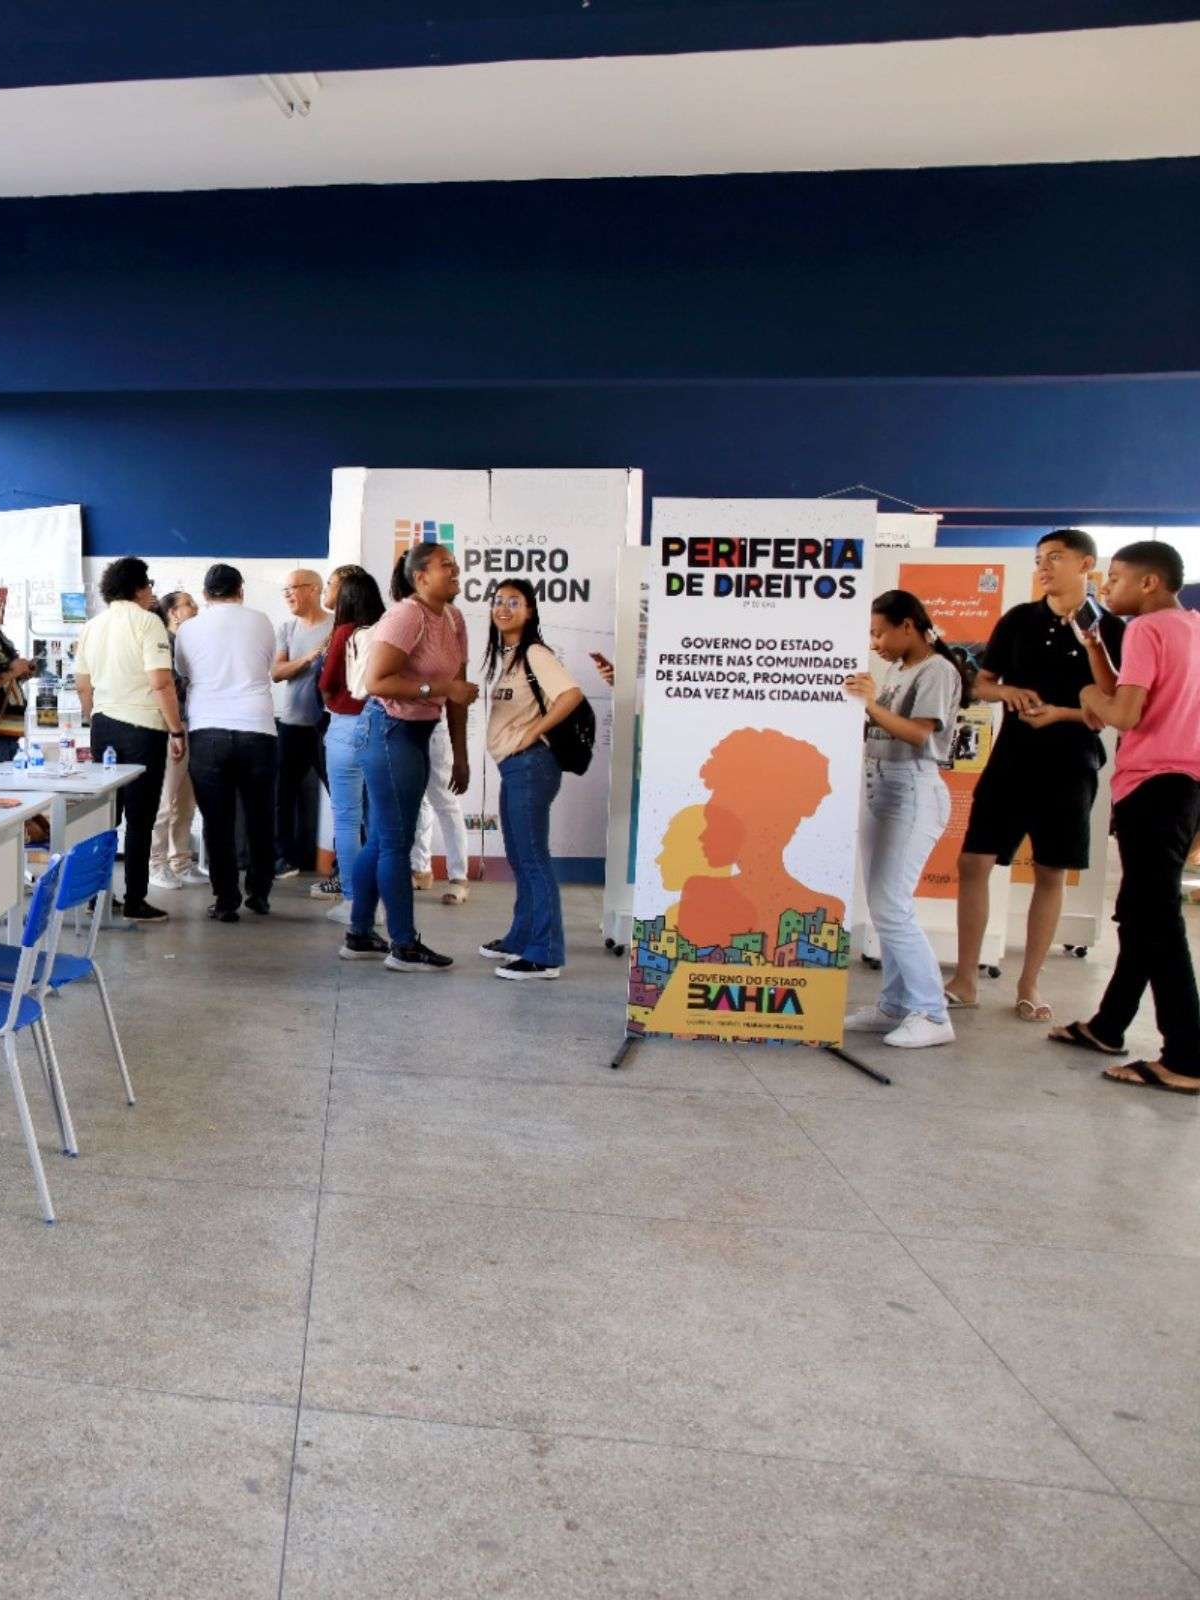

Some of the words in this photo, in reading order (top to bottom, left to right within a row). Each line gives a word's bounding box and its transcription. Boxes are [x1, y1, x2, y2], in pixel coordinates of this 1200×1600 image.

[464, 548, 569, 573] PEDRO
[662, 537, 863, 569] PERIFERIA
[666, 572, 704, 597] DE
[714, 573, 856, 599] DIREITOS
[681, 637, 751, 650] GOVERNO
[755, 639, 777, 651] DO
[781, 640, 833, 652] ESTADO
[659, 653, 723, 666] PRESENTE
[726, 655, 753, 667] NAS
[756, 656, 858, 669] COMUNIDADES
[656, 670, 673, 682] DE
[676, 670, 750, 685] SALVADOR,
[665, 687, 702, 699] CADA
[705, 688, 730, 699] VEZ
[733, 689, 766, 701] MAIS
[769, 690, 847, 702] CIDADANIA.
[689, 973, 743, 984] GOVERNO
[745, 975, 762, 985] DO
[764, 976, 807, 988] ESTADO
[688, 983, 804, 1015] BAHIA
